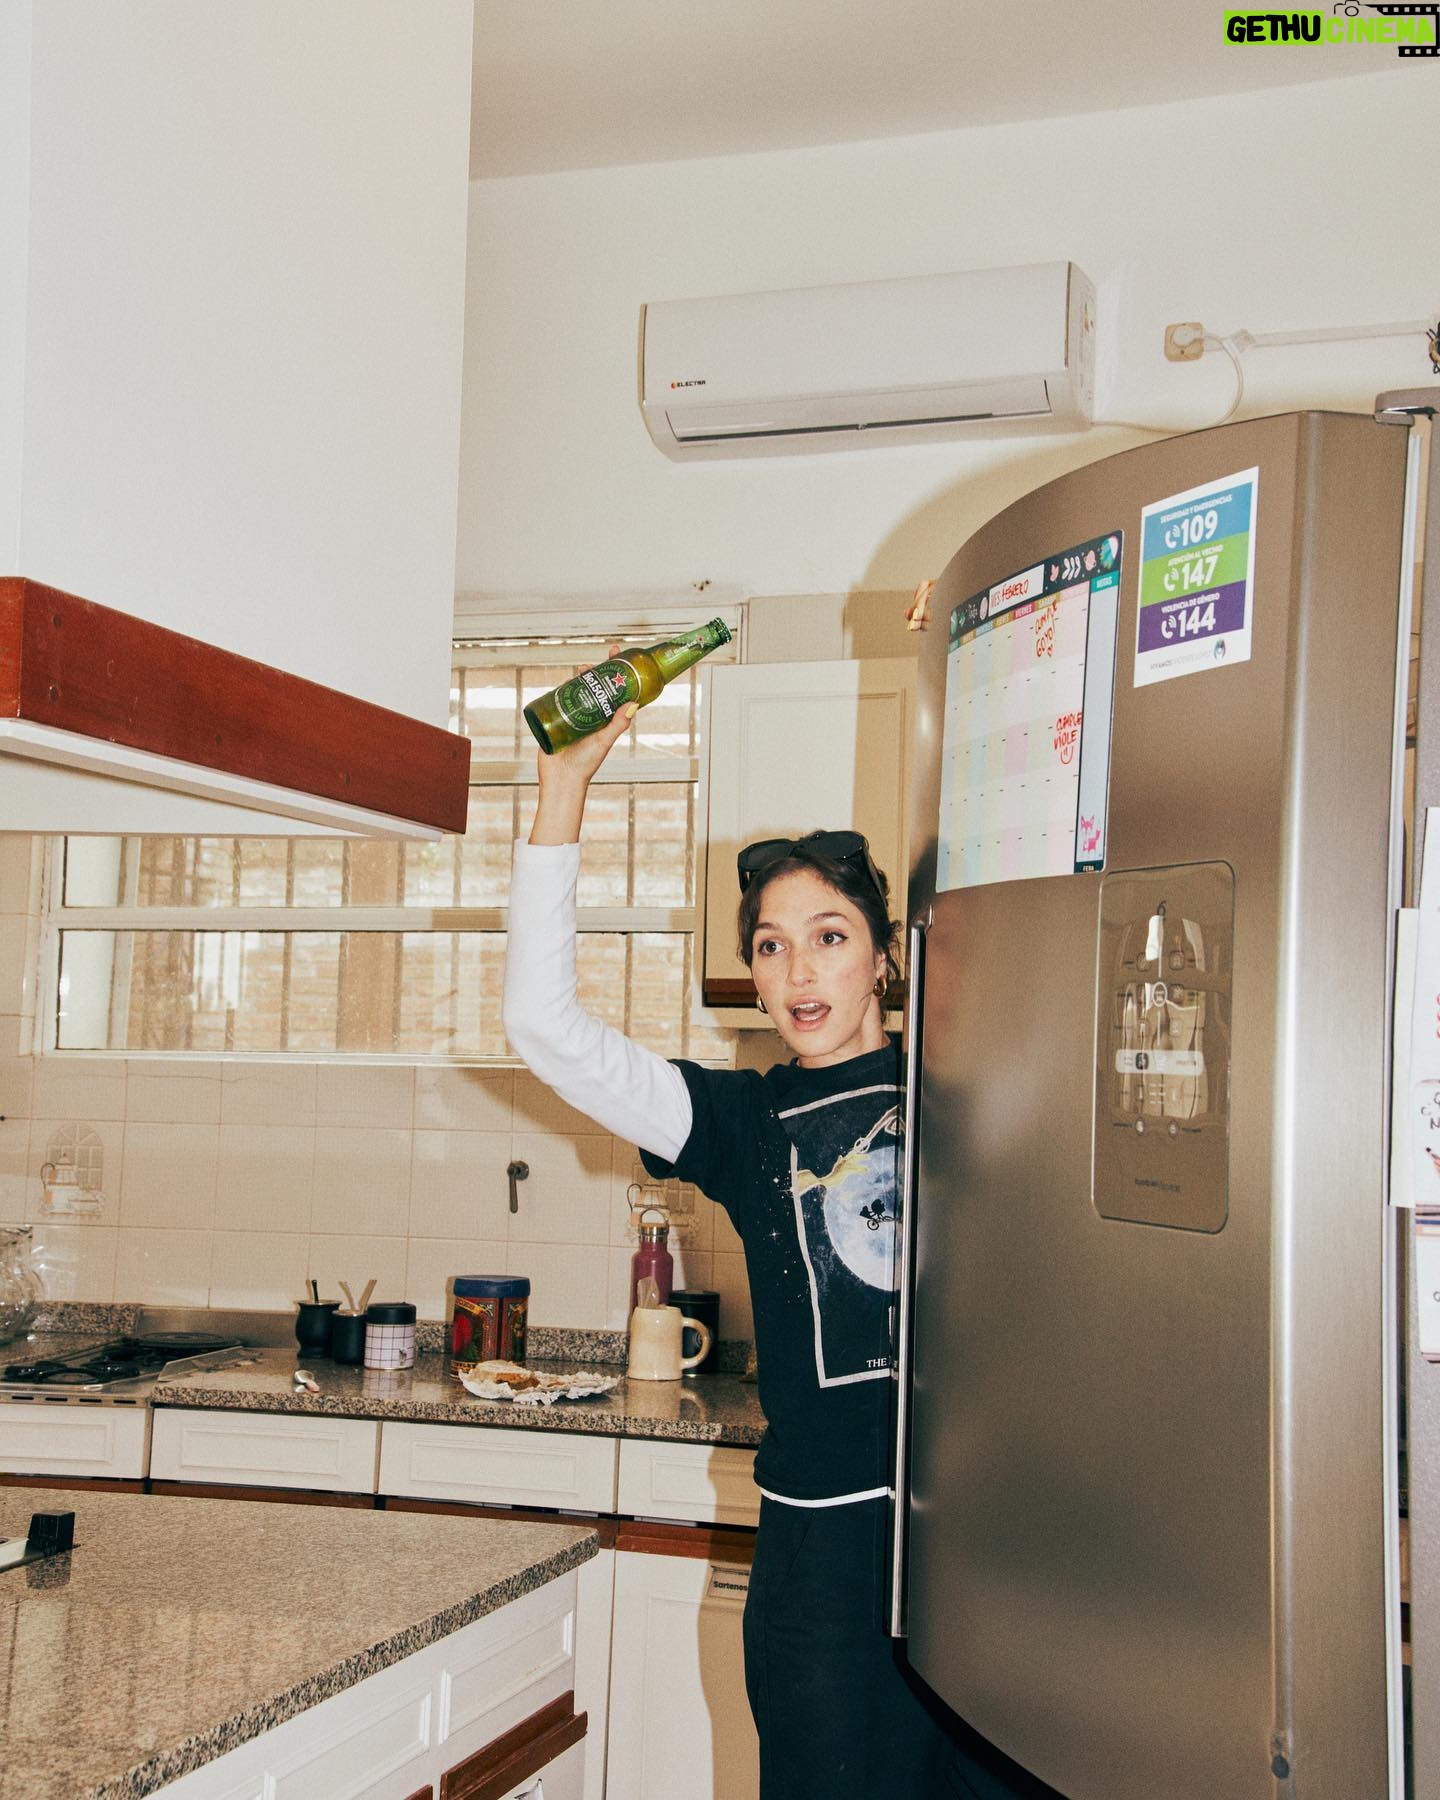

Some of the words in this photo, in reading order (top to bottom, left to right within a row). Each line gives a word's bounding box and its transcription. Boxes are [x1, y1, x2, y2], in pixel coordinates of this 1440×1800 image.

[1181, 509, 1218, 547] 109
[1182, 555, 1218, 590] 147
[1178, 603, 1216, 638] 144
[1054, 729, 1078, 750] VIOLE
[866, 1357, 888, 1370] THE
